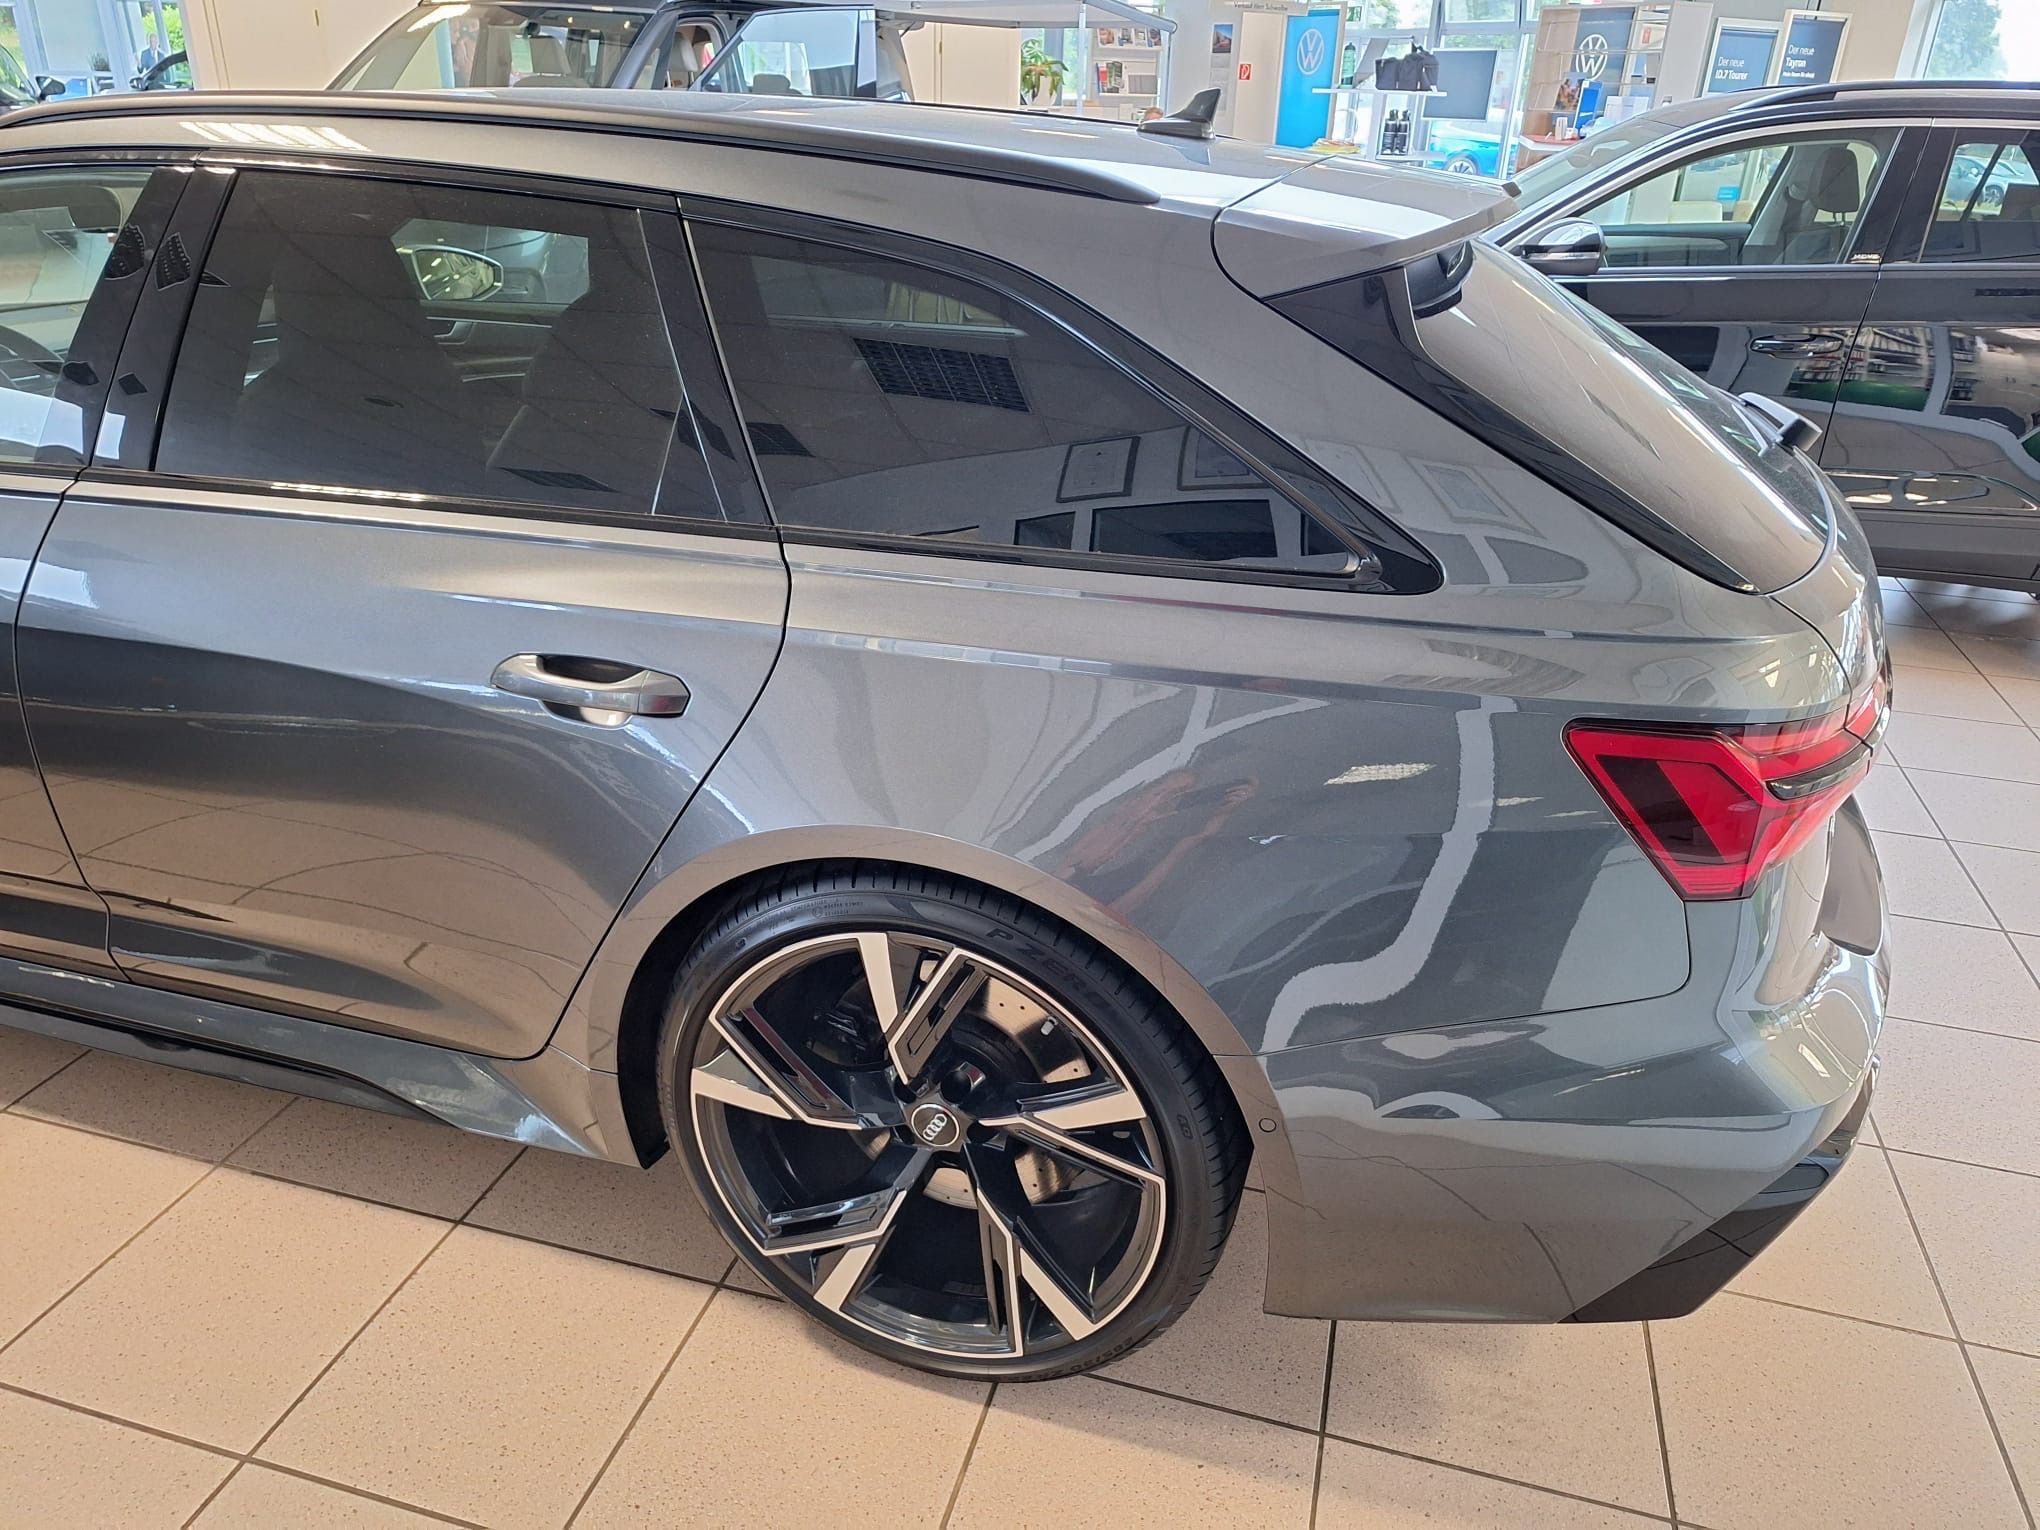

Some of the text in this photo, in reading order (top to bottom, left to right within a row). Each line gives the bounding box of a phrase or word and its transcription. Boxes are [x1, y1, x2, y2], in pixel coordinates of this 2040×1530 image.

[1788, 44, 1815, 56] Der neue
[1718, 56, 1745, 68] Der neue
[1728, 70, 1748, 81] Tourer
